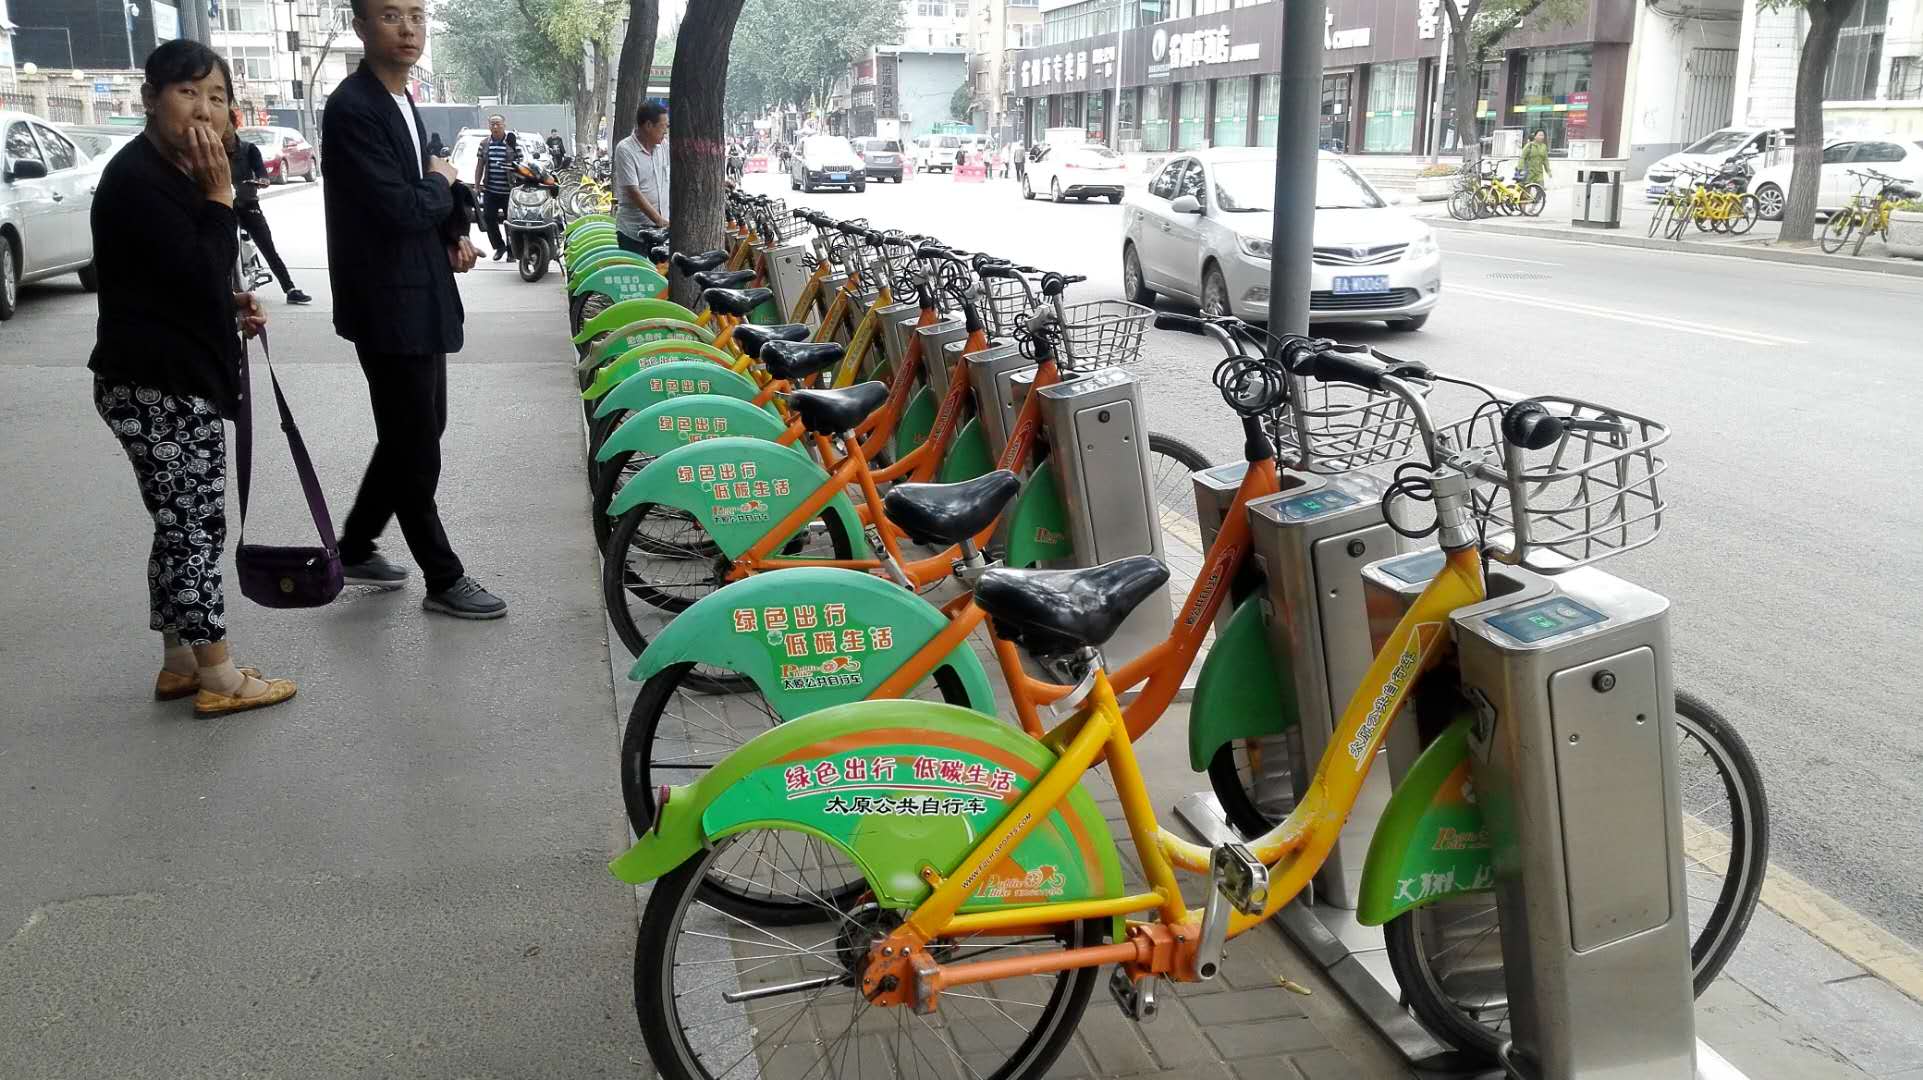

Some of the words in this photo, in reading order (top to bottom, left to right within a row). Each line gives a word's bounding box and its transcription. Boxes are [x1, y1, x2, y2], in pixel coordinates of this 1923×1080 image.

[659, 416, 727, 433] 绿色出行
[677, 462, 756, 482] 绿色出行
[713, 479, 790, 500] 低碳生活
[734, 603, 846, 632] 绿色出行
[784, 626, 892, 657] 低碳生活
[783, 673, 863, 690] 太原公共自行车
[1349, 651, 1416, 757] 太原公共自行车
[784, 756, 896, 791] 绿色出行
[913, 756, 1016, 793] 低碳生活
[825, 796, 988, 816] 太原公共自行车
